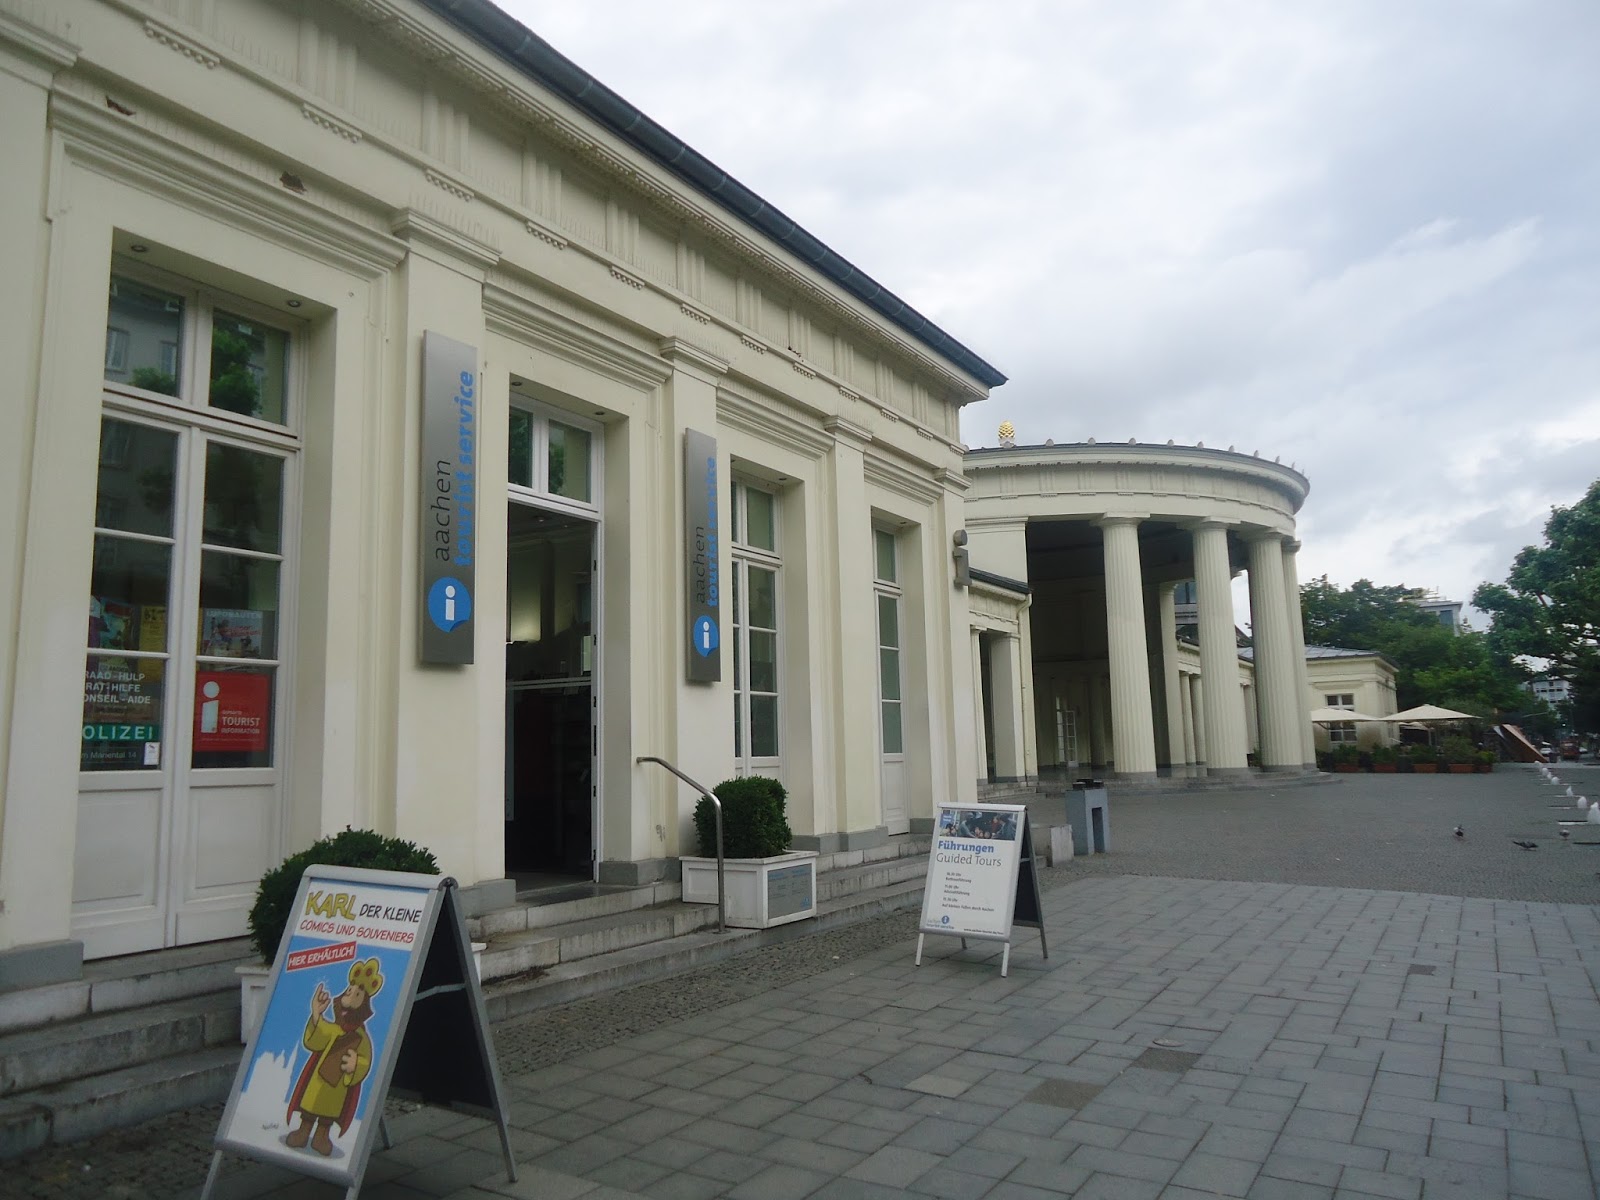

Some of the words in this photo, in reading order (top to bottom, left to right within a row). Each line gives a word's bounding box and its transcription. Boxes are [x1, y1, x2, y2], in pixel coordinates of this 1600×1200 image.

[453, 370, 474, 465] service
[705, 457, 717, 529] service
[430, 460, 451, 562] aachen
[453, 470, 473, 566] tourist
[693, 526, 705, 603] aachen
[705, 534, 718, 607] tourist
[86, 682, 105, 691] RAT
[111, 682, 141, 693] HILFE
[118, 672, 145, 681] HULP
[83, 694, 120, 703] ONSEIL
[127, 695, 151, 704] AIDE
[82, 725, 153, 740] OLIZEI
[222, 716, 261, 727] TOURIST
[938, 840, 994, 855] Führungen
[936, 852, 972, 865] Guided
[975, 855, 1002, 867] Tours
[304, 890, 357, 921] KARL
[359, 903, 382, 919] DER
[382, 905, 422, 923] KLEINE
[300, 919, 335, 933] COMICS
[335, 925, 356, 936] UND
[356, 926, 415, 944] SOUVENIERS
[288, 954, 307, 967] HIER
[307, 945, 355, 964] ERHÄLTLICH!
